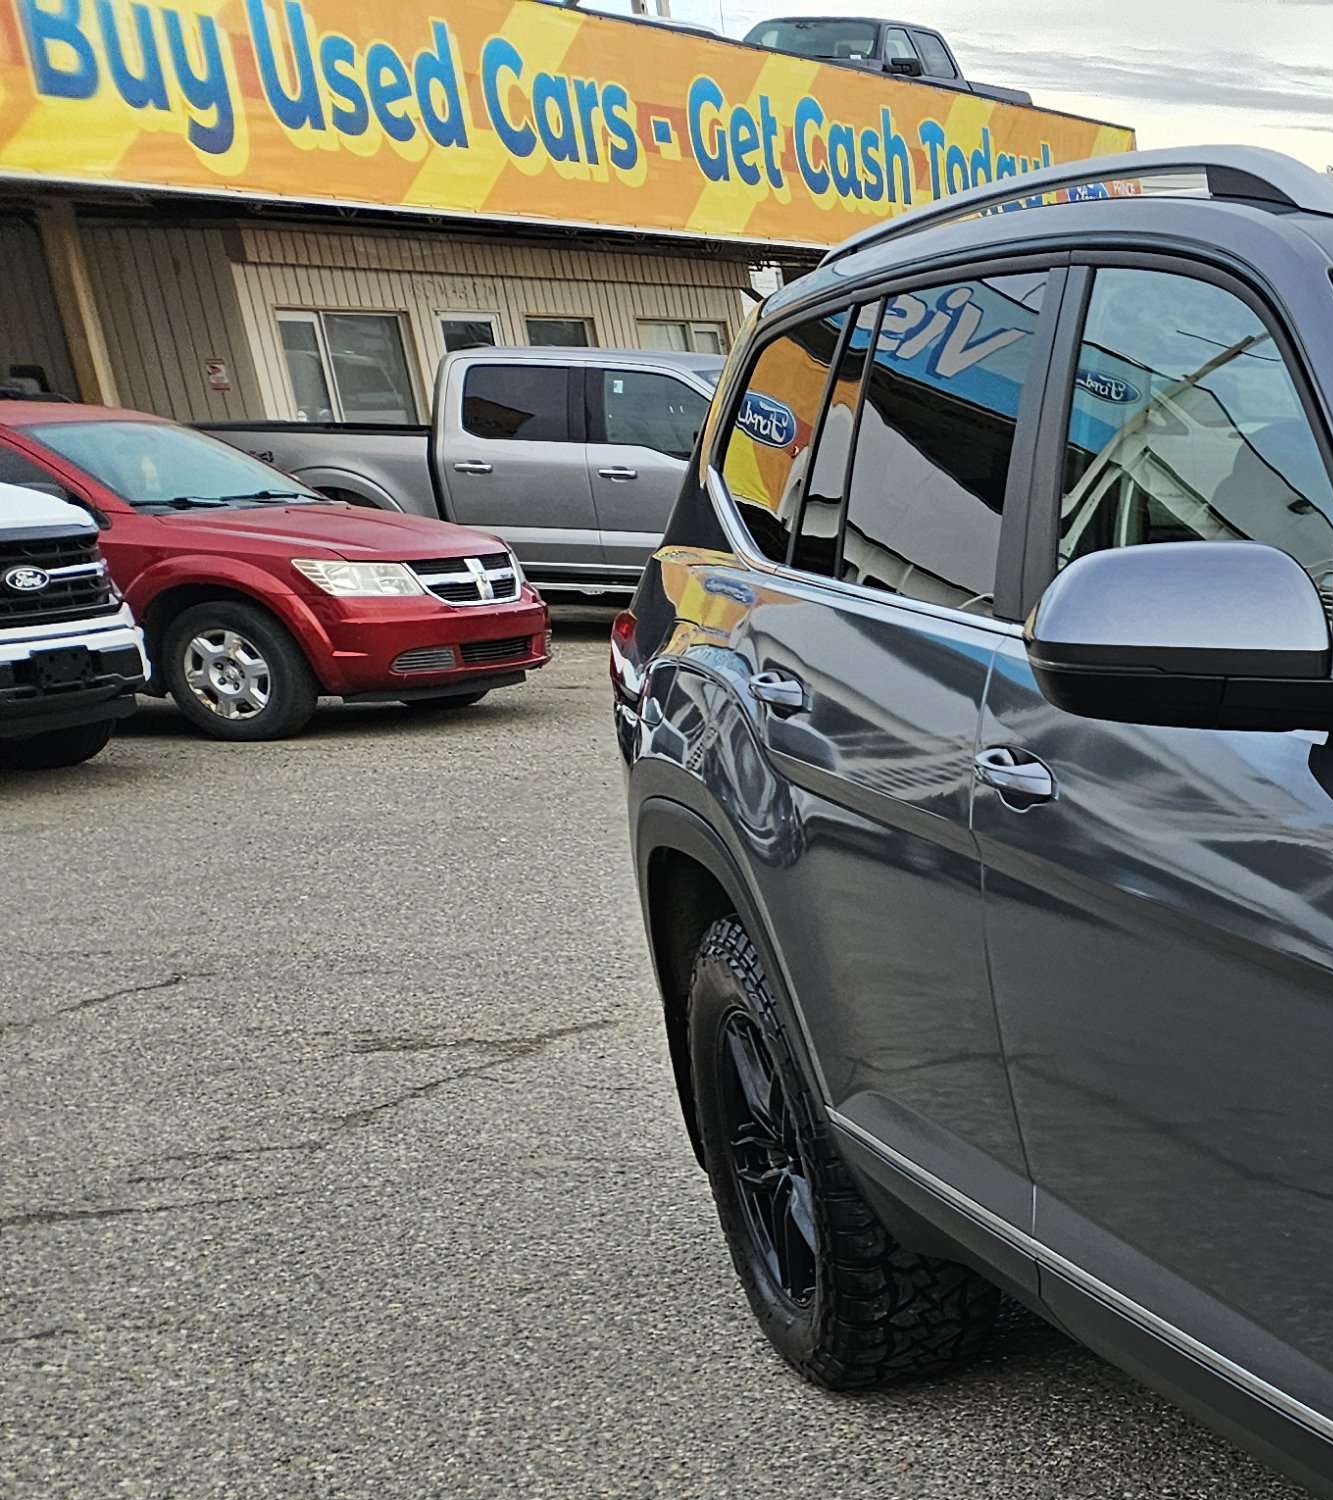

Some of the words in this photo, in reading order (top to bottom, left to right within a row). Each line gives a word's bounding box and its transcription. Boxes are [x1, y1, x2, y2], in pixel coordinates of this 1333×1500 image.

[22, 0, 235, 155] Buy
[245, 0, 469, 149] Used
[482, 37, 638, 171] Cars
[688, 76, 784, 189] Get
[795, 96, 912, 205] Cash
